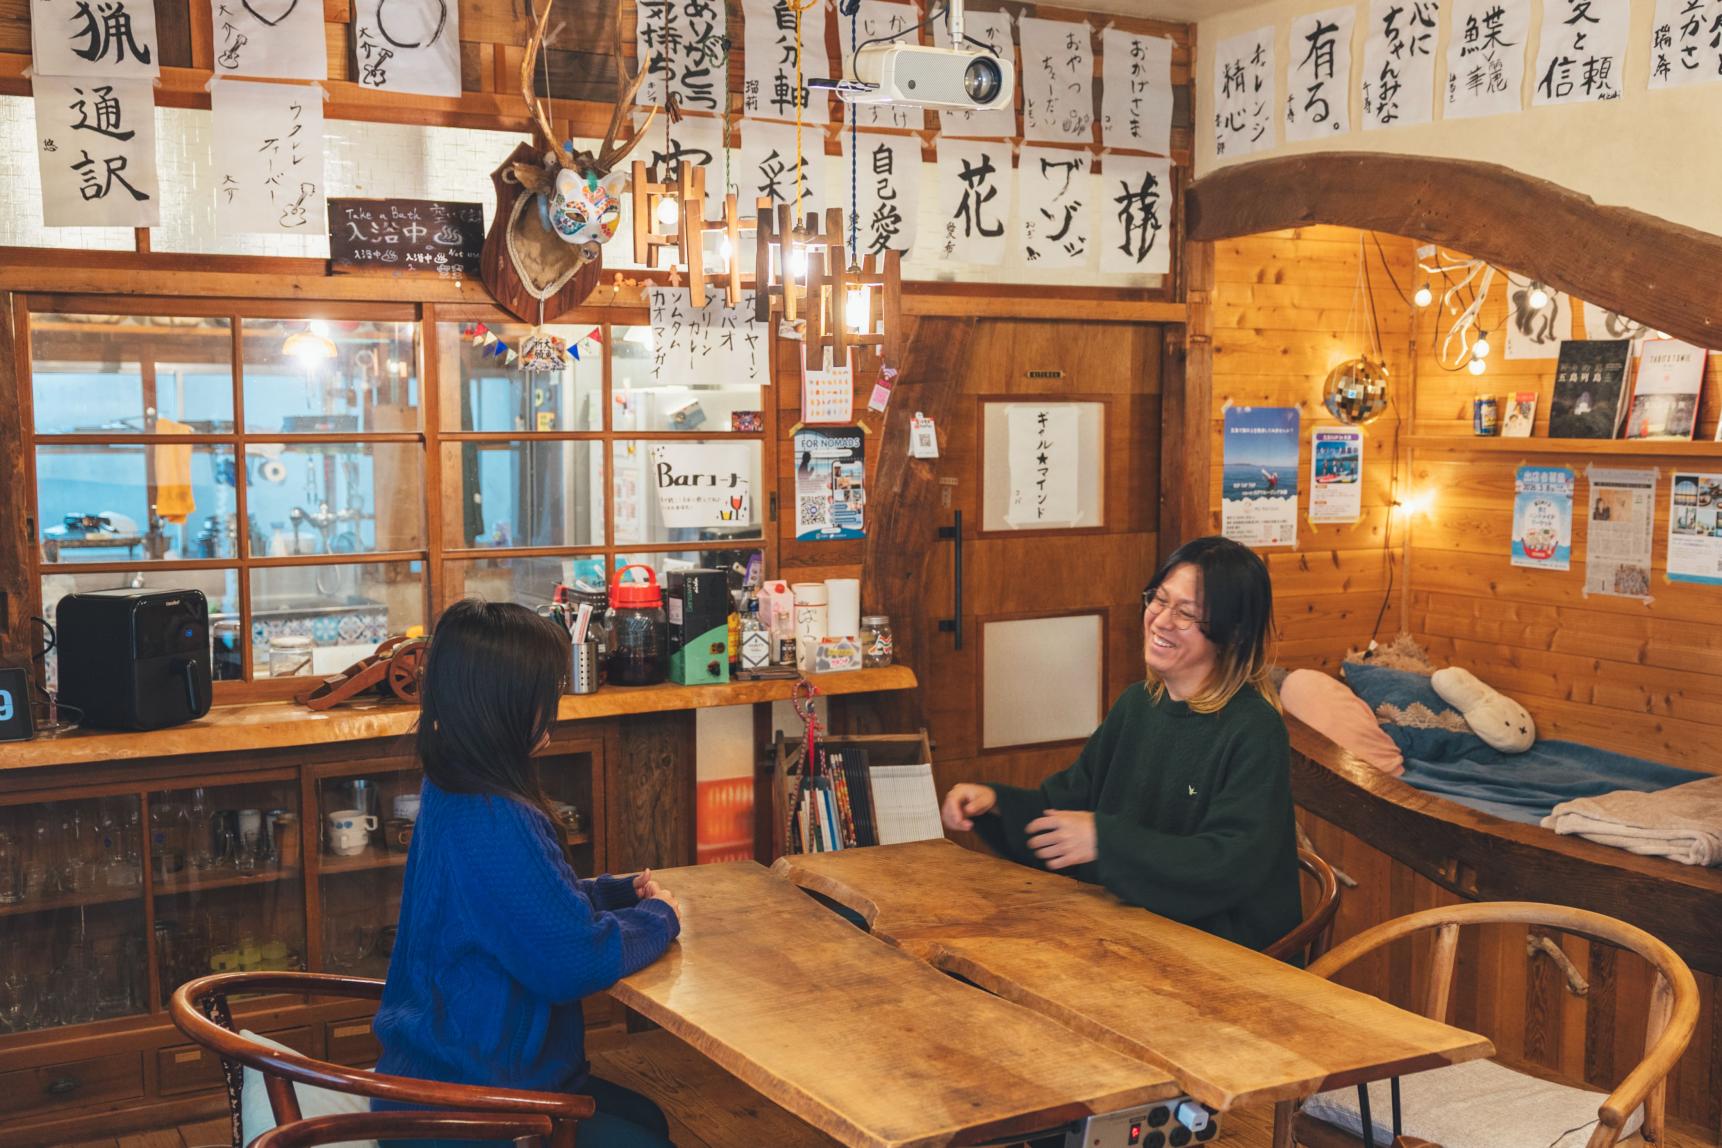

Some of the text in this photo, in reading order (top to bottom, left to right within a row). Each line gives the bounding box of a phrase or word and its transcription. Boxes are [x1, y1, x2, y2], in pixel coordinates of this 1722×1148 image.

[1409, 1, 1440, 57] 心に
[1065, 32, 1082, 94] おやつ
[1129, 40, 1149, 138] おかげさま
[1297, 19, 1341, 130] 有る。
[1376, 6, 1405, 124] ちゃんみな
[1537, 55, 1615, 99] 信頼
[69, 85, 150, 202] 通訳
[345, 207, 373, 220] Take
[391, 206, 421, 220] Bath
[868, 141, 910, 259] 自己愛
[954, 153, 1005, 238] 花
[346, 221, 427, 244] 入浴中
[650, 290, 667, 380] カオマンガイ
[670, 292, 684, 349] ソムタム
[688, 320, 700, 370] カレー
[801, 437, 861, 449] FOR NOMADS
